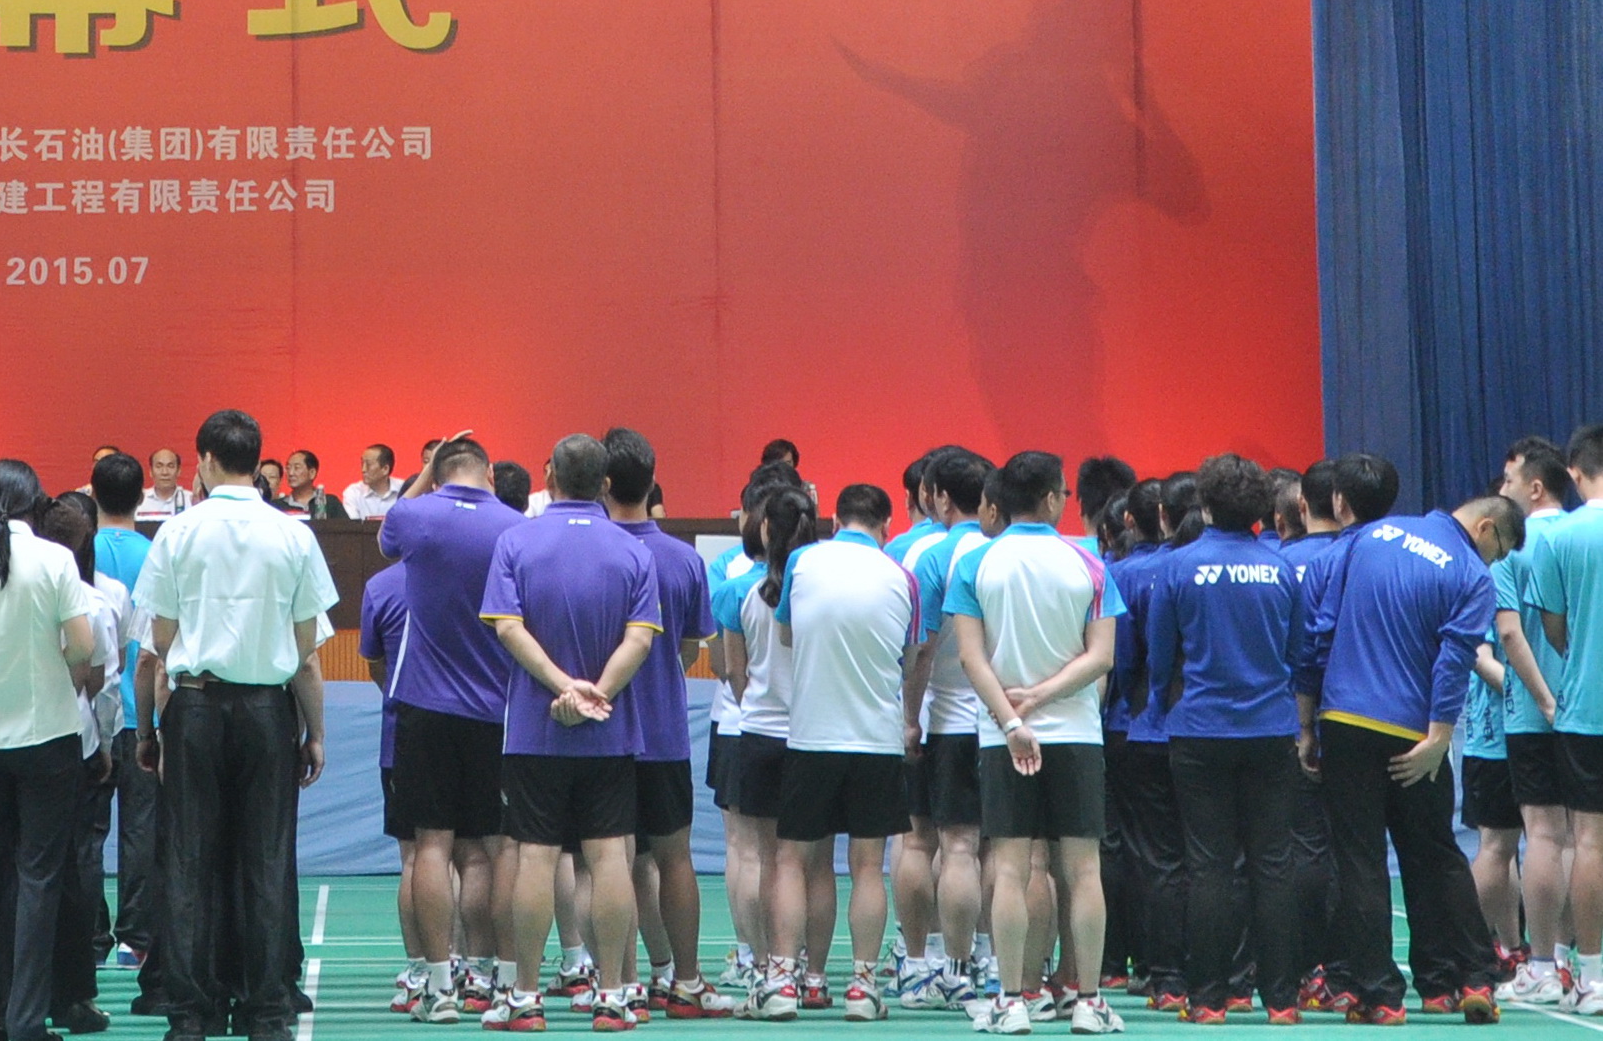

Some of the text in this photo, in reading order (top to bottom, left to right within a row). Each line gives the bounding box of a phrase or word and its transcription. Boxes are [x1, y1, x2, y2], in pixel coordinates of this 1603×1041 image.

[6, 256, 150, 286] 2015.07
[1401, 532, 1454, 570] YONEX
[1226, 564, 1280, 585] YONEX
